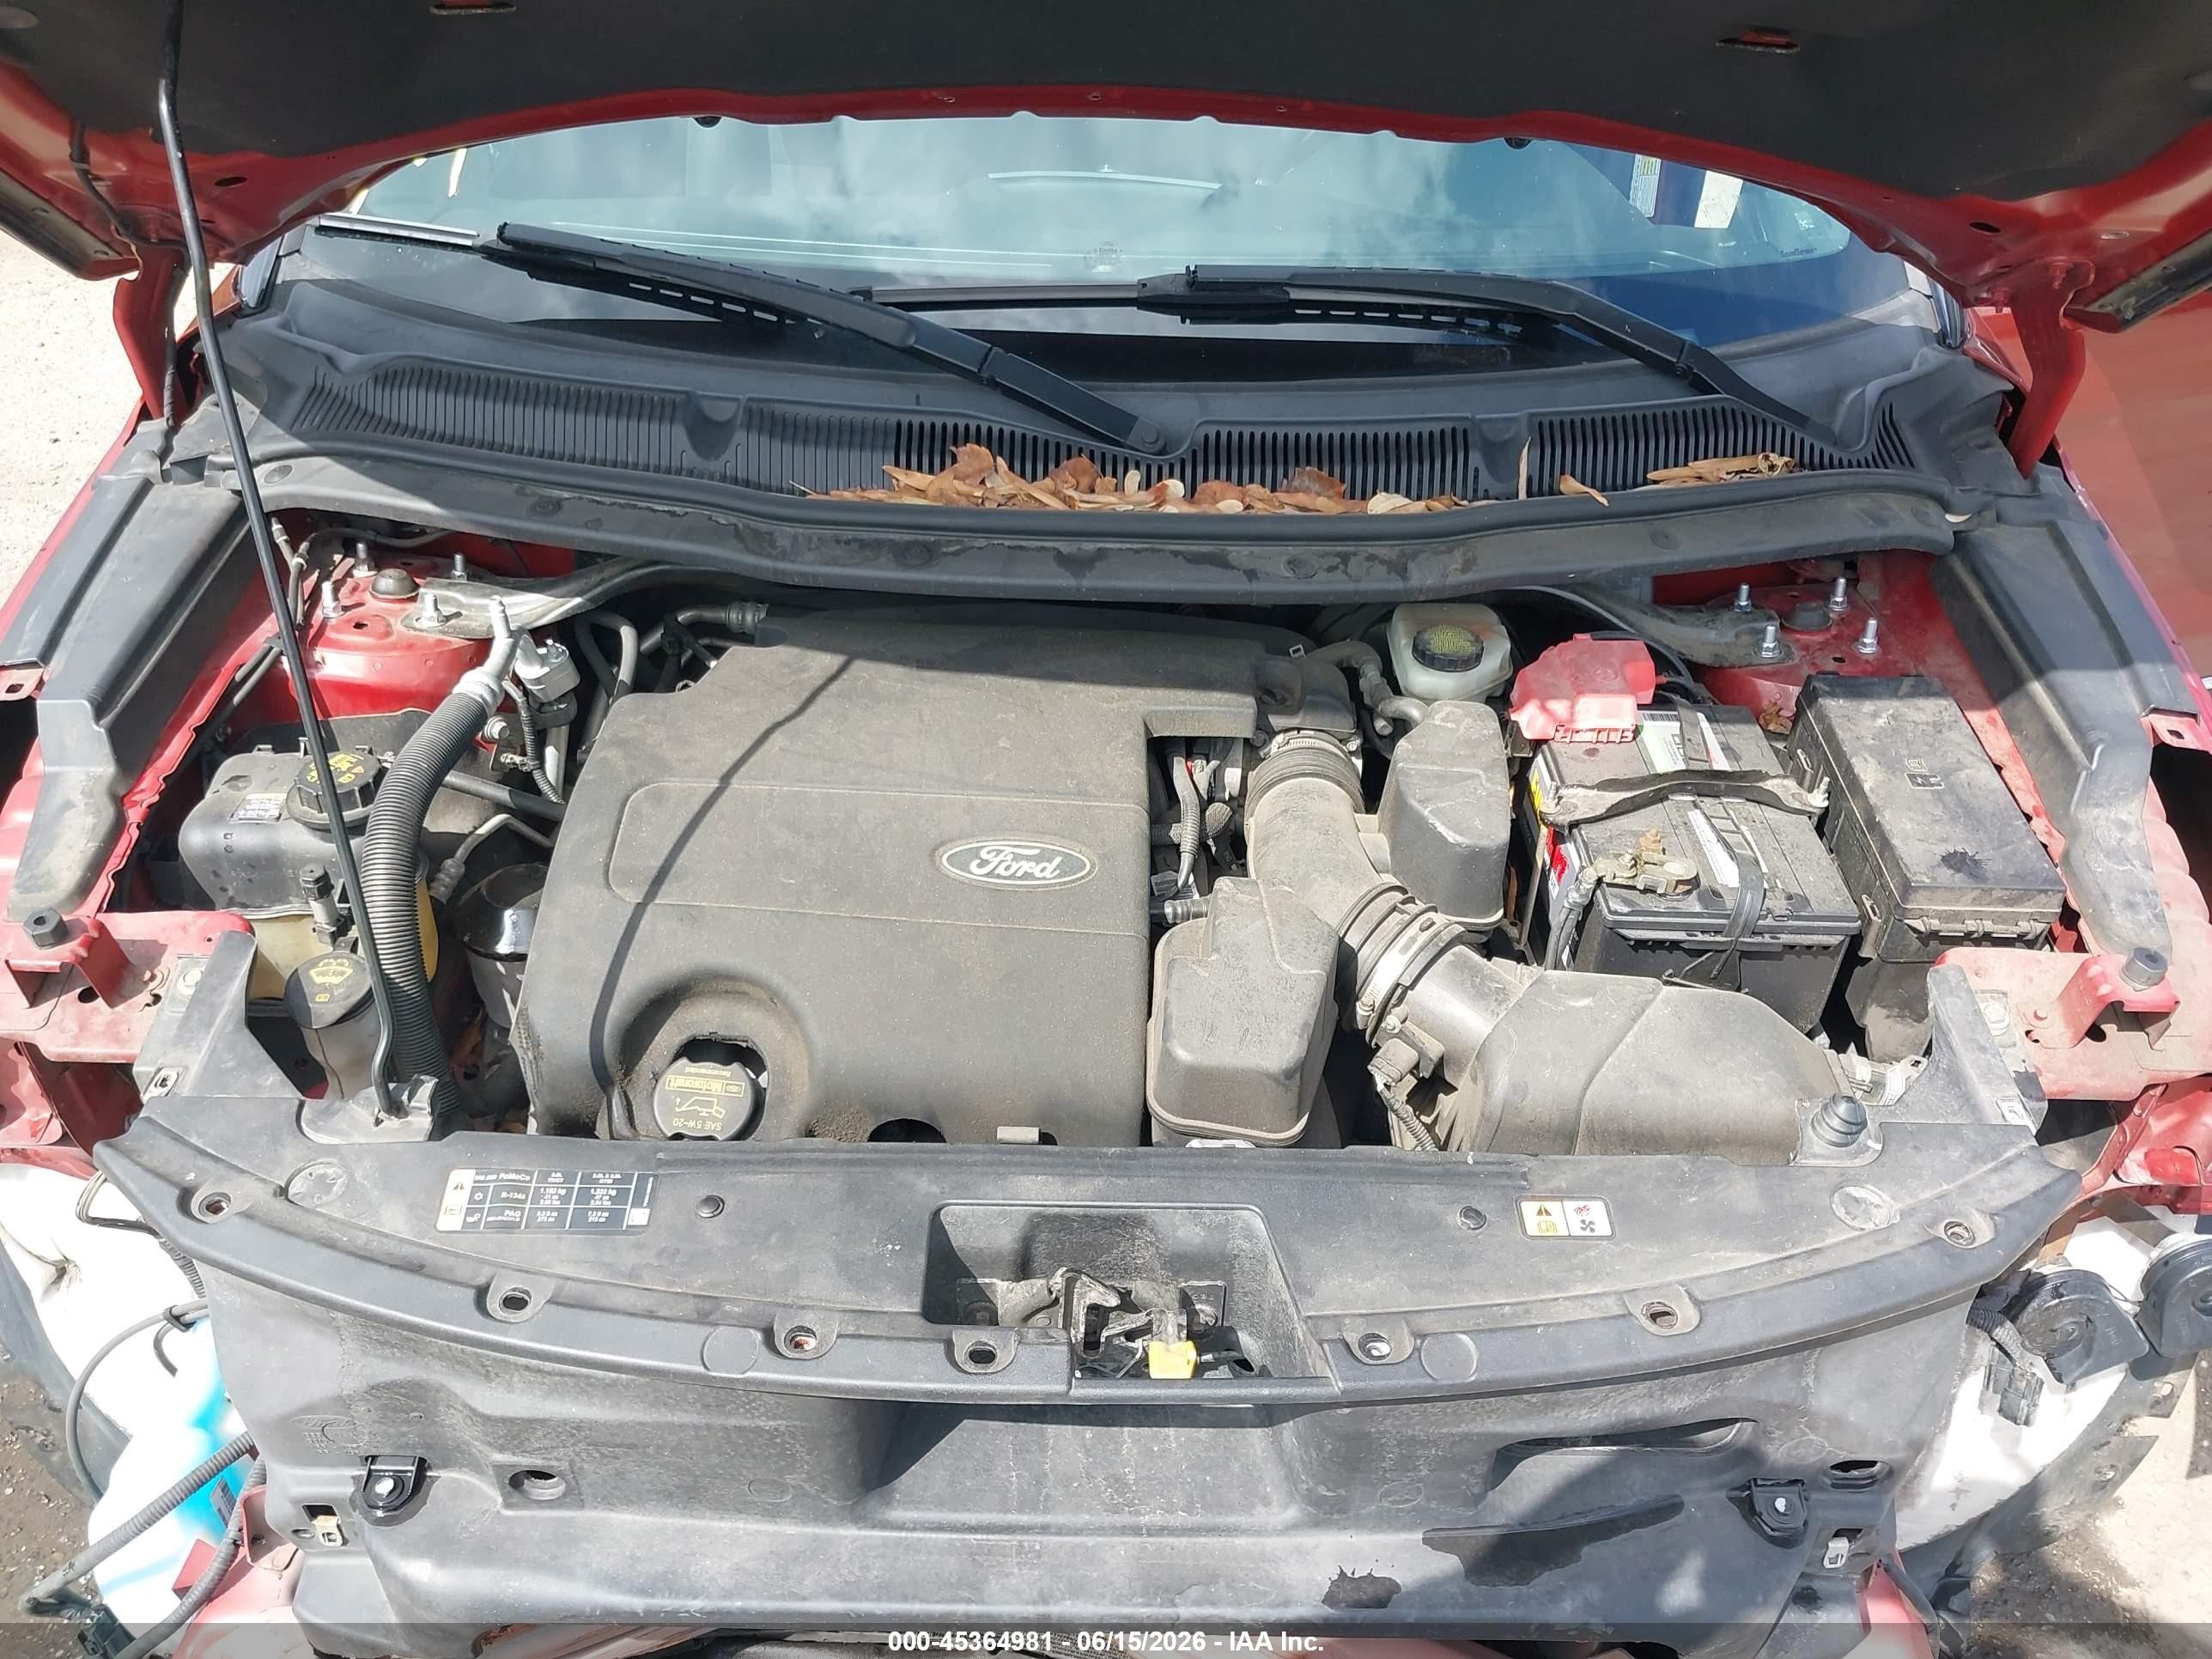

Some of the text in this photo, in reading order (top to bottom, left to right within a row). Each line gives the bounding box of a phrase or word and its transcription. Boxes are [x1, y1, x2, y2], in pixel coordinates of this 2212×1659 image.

[969, 845, 1063, 879] Ford
[670, 1076, 723, 1093] Motorcraft
[672, 1117, 722, 1131] SAE 5W-20
